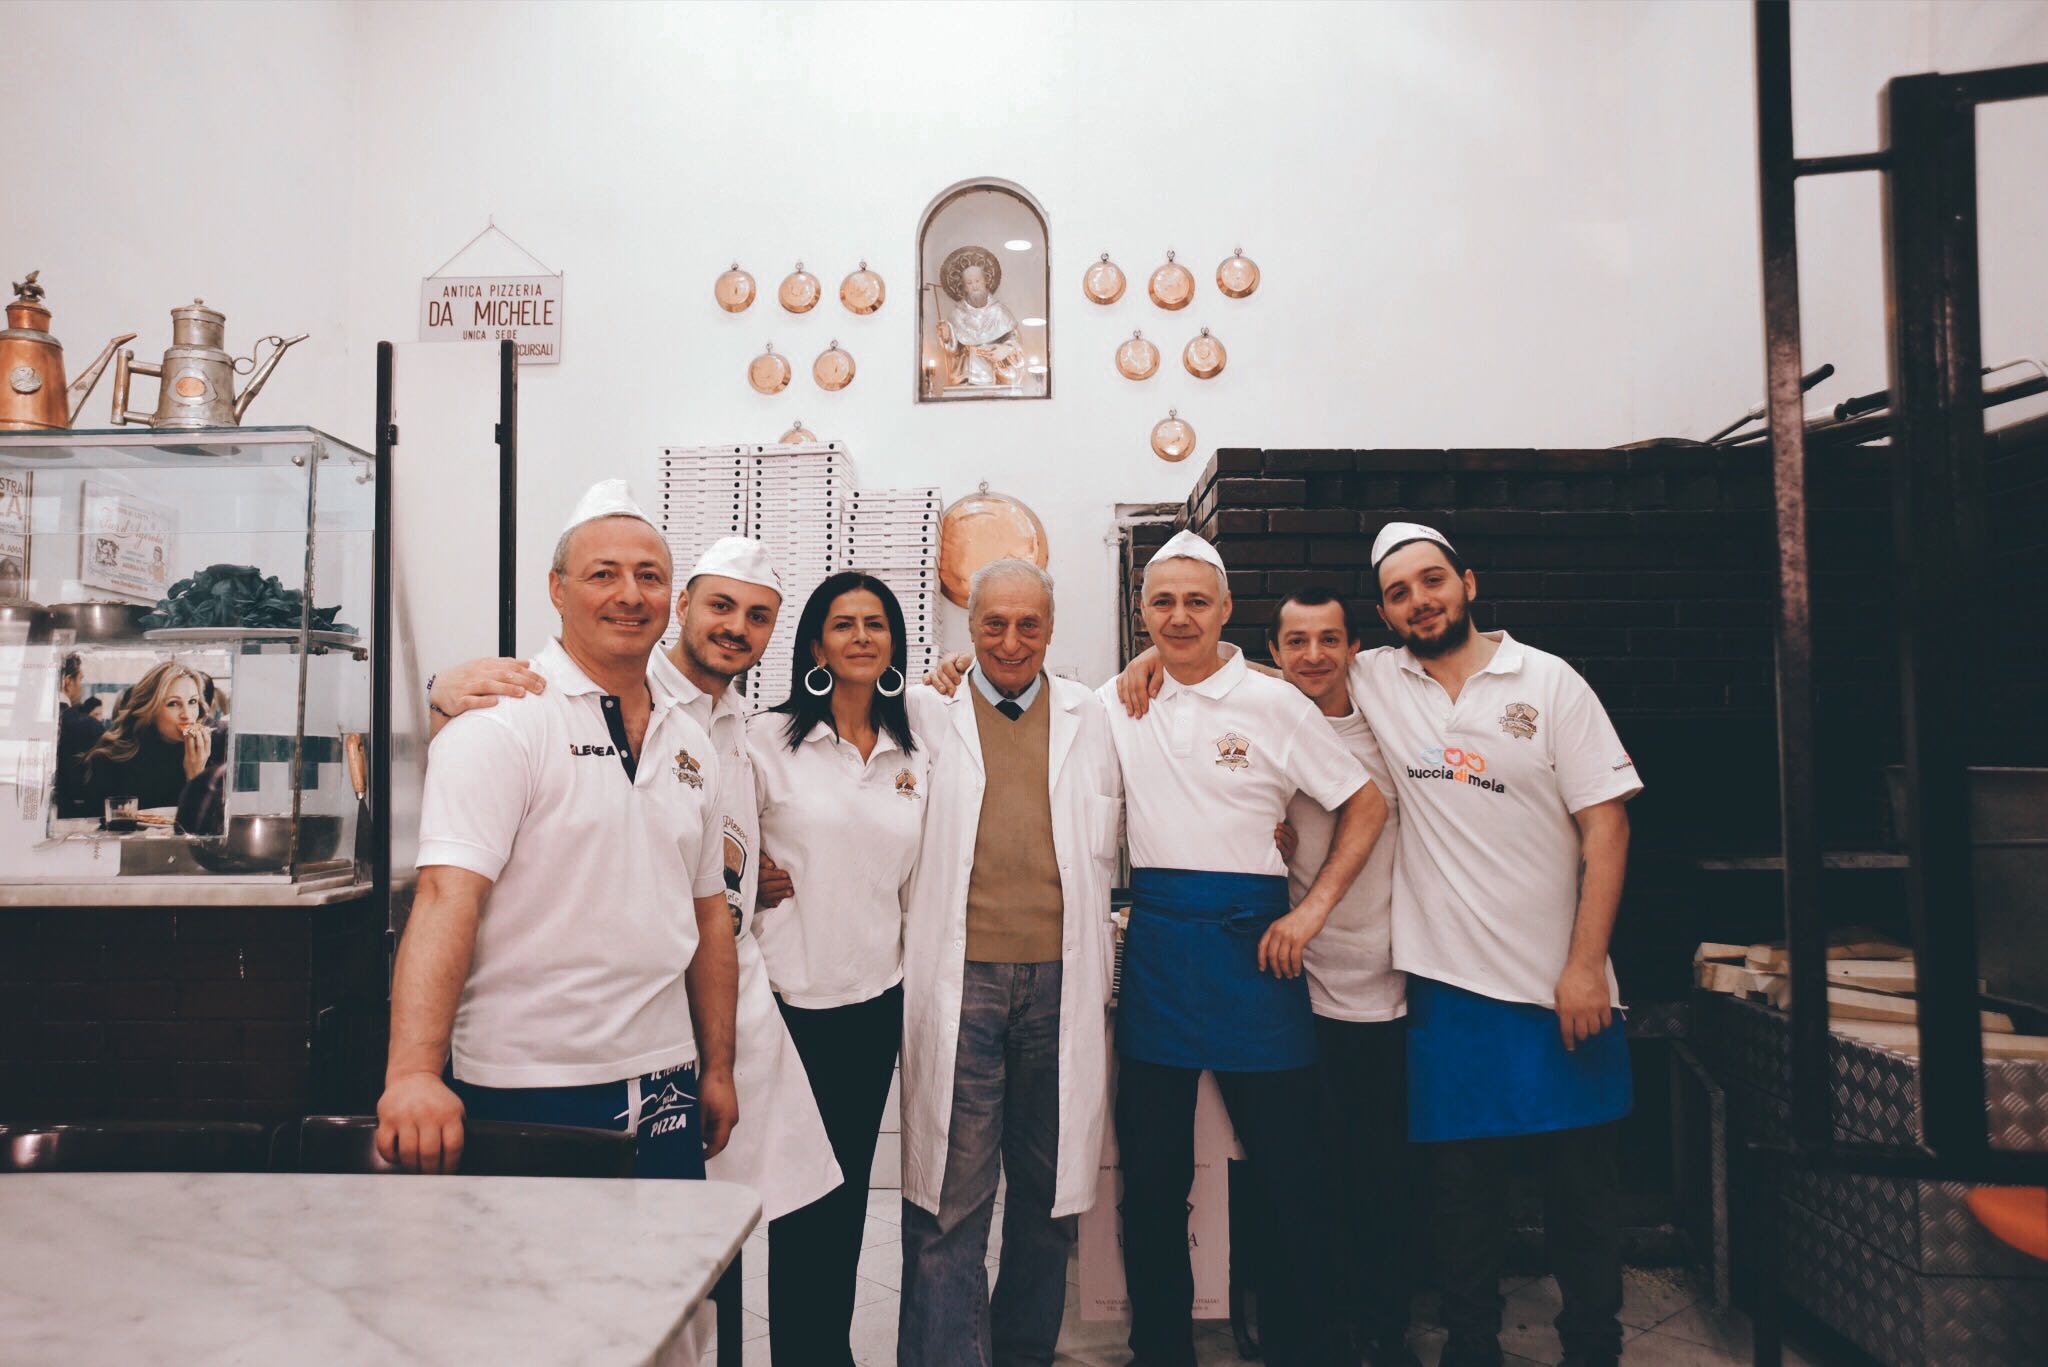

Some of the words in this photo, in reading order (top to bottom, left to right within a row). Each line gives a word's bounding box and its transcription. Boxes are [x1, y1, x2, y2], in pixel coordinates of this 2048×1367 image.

[443, 285, 482, 297] ANTICA
[490, 284, 542, 297] PIZZERIA
[429, 301, 453, 327] DA
[474, 300, 554, 326] MICHELE
[463, 330, 486, 340] UNICA
[495, 329, 517, 340] SEDE
[1406, 765, 1505, 793] bucciadimela
[650, 1113, 687, 1138] PIZZA
